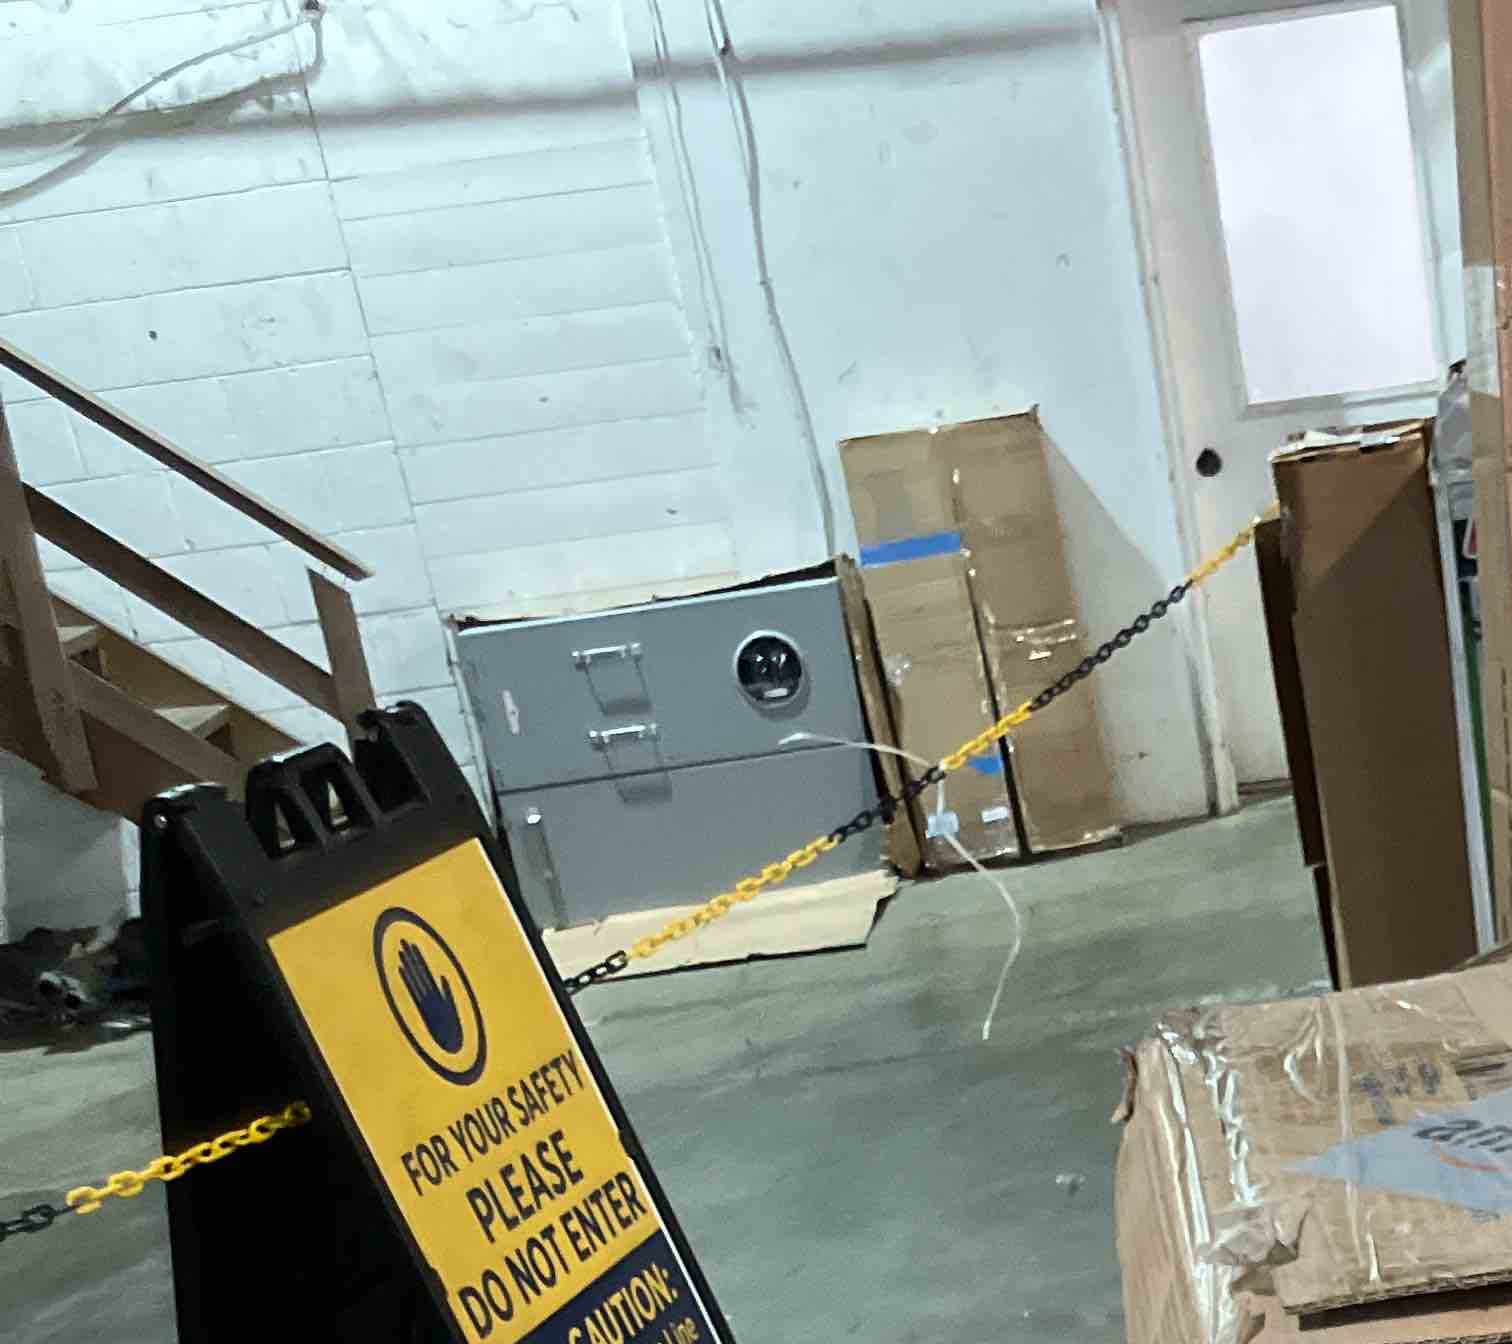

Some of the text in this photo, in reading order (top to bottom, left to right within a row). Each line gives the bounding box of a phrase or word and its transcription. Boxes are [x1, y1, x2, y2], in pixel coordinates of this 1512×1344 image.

[400, 1049, 585, 1196] FOR YOUR SAFETY
[465, 1130, 584, 1244] PLEASE
[457, 1170, 648, 1340] DO NOT ENTER
